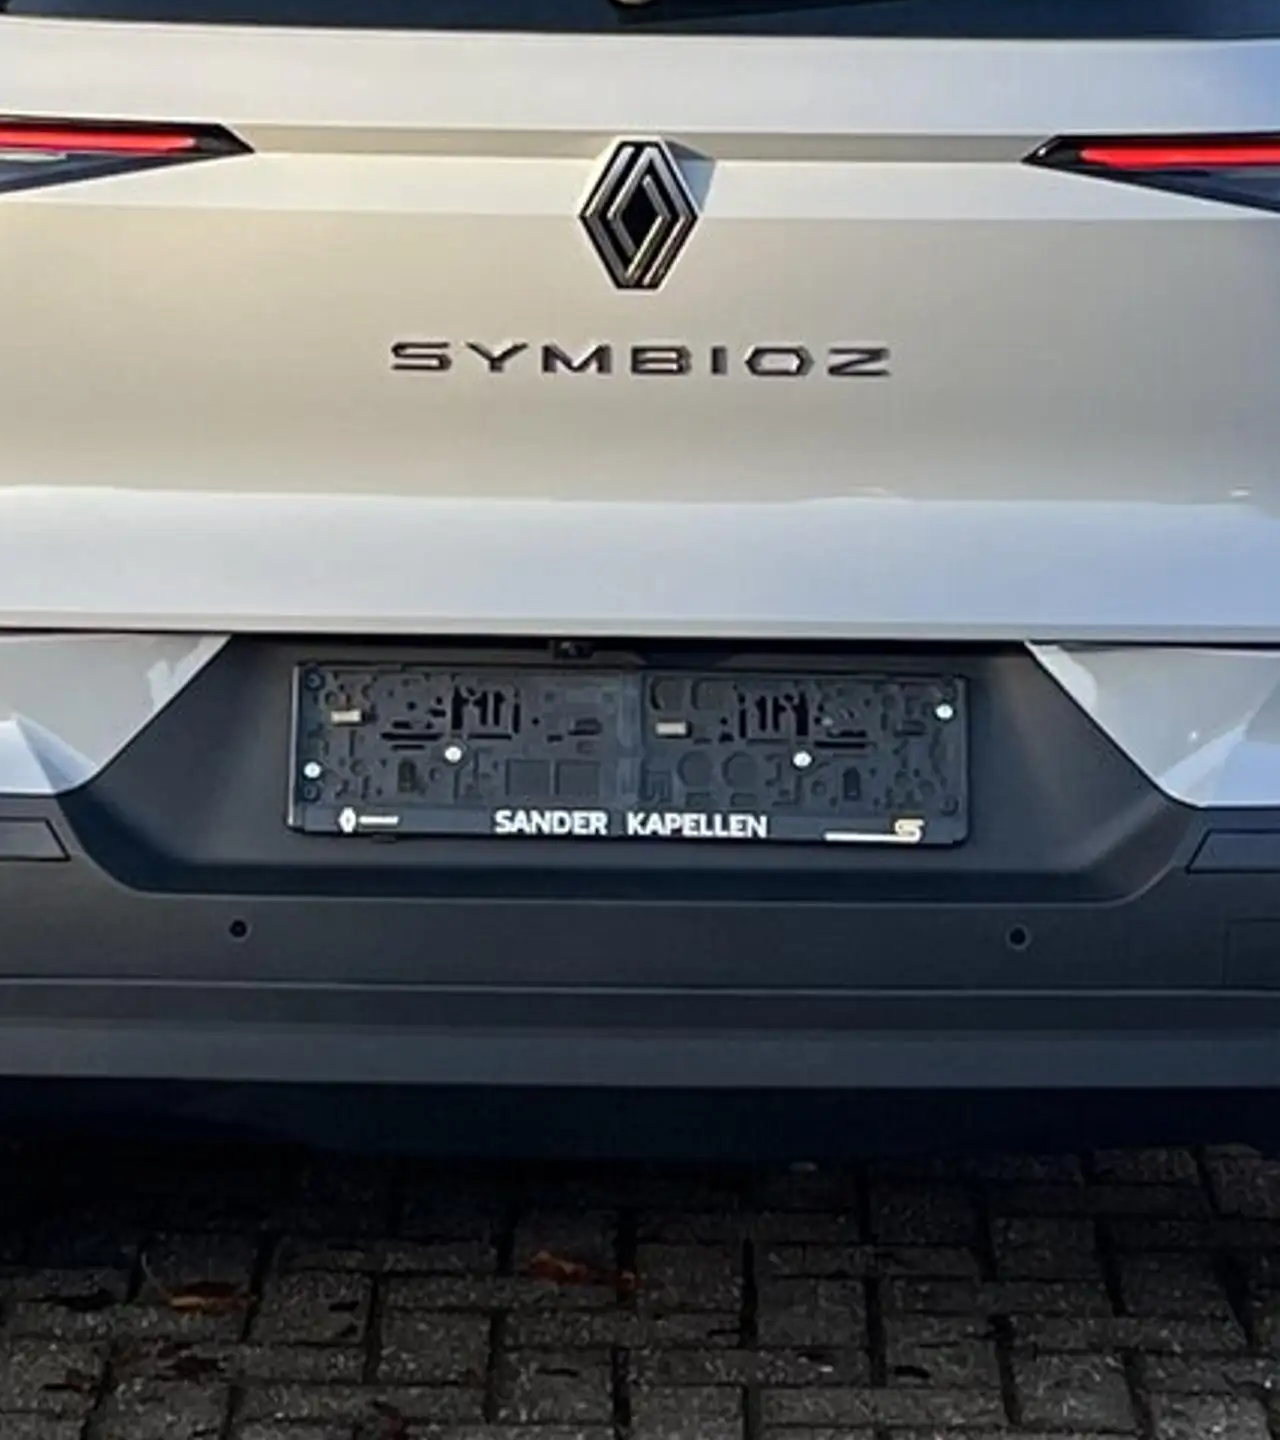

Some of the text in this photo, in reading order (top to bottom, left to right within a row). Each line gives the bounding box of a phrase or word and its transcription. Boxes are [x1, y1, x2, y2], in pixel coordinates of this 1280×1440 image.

[390, 341, 892, 378] SYMBIOZ
[494, 809, 768, 839] SANDER KAPELLEN
